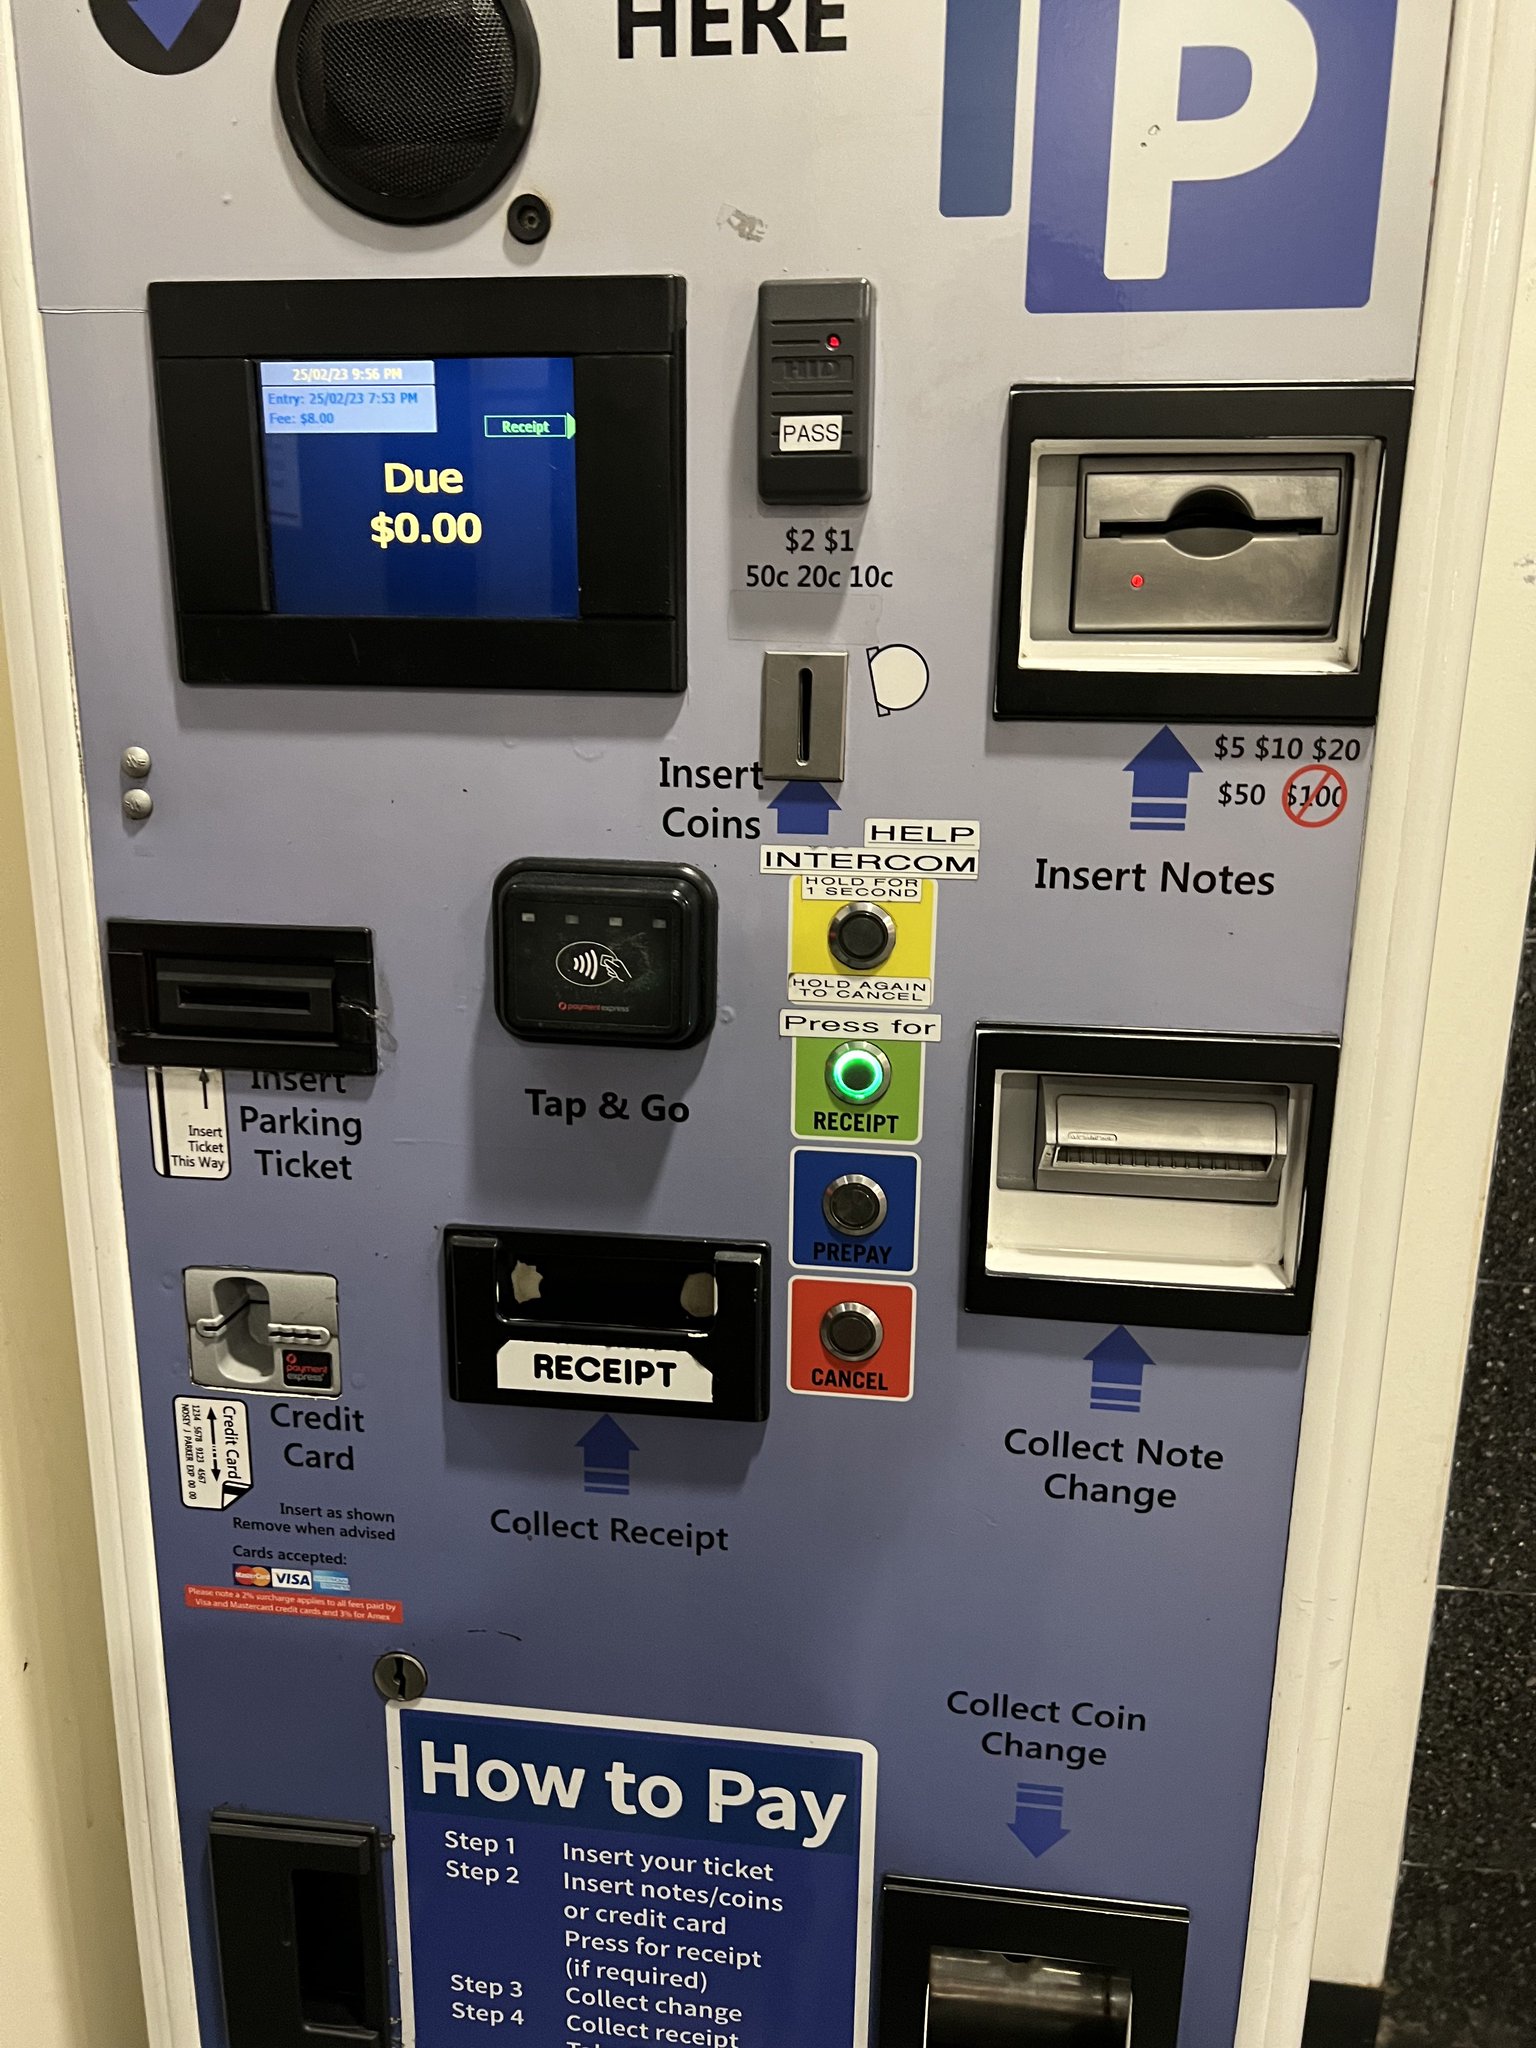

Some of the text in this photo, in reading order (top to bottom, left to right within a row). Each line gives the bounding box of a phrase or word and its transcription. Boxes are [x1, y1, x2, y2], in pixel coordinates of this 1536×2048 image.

[618, 0, 847, 59] HERE
[1103, 0, 1318, 280] P
[292, 368, 403, 382] 25/02/23 9:56 PM
[783, 360, 841, 380] HID
[268, 392, 418, 407] Entry: 25/02/23 7:53 PM
[269, 412, 335, 425] Fee: $8.00
[502, 420, 551, 436] Receipt
[783, 423, 839, 443] PASS
[384, 462, 464, 494] Due
[370, 511, 482, 549] $0.00
[785, 526, 854, 554] $2 $1
[746, 565, 894, 588] 50c 20c 10c
[1214, 733, 1361, 763] $5 $10 $20
[659, 757, 764, 790] Insert
[1218, 781, 1266, 807] $50
[662, 806, 761, 840] Coins
[871, 825, 975, 843] HELP
[765, 851, 976, 873] INTERCOM
[805, 876, 918, 888] HOLD FOR
[1034, 858, 1275, 896] Insert Notes
[807, 887, 918, 898] 1 SECOND
[792, 978, 926, 992] HOLD AGAIN
[798, 988, 923, 1002] TO CANCEL
[785, 1015, 936, 1035] Press for
[251, 1070, 347, 1094] Insert
[525, 1088, 690, 1126] Tap & Go
[188, 1125, 223, 1138] Insert
[239, 1105, 363, 1146] Parking
[813, 1111, 899, 1134] RECEIPT
[188, 1140, 224, 1154] Ticket
[170, 1155, 226, 1172] This Way
[254, 1149, 353, 1180] Ticket
[813, 1242, 892, 1264] PREPAY
[534, 1353, 677, 1388] RECEIPT
[811, 1368, 888, 1391] CANCEL
[182, 1403, 191, 1427] NOSEY
[270, 1402, 366, 1433] Credit
[184, 1436, 193, 1461] PARKER
[192, 1405, 206, 1484] 1234 5678 9123 4567
[223, 1405, 241, 1480] Credit Card
[1004, 1428, 1224, 1470] Collect Note
[283, 1442, 355, 1471] Card
[186, 1465, 195, 1477] EXP
[1044, 1473, 1177, 1514] Change
[280, 1503, 395, 1523] Insert as shown
[233, 1517, 395, 1541] Remove when advised
[490, 1509, 729, 1556] Collect Receipt
[233, 1545, 347, 1566] Cards accepted:
[276, 1573, 310, 1586] VISA
[188, 1587, 214, 1596] Please
[242, 1591, 255, 1599] 2%
[256, 1593, 295, 1603] surcharge
[347, 1600, 364, 1608] fees
[366, 1602, 384, 1611] paid
[386, 1603, 396, 1612] by
[275, 1604, 298, 1613] credit
[300, 1607, 321, 1615] cards
[322, 1609, 338, 1617] and
[367, 1612, 390, 1620] Amex
[947, 1690, 1146, 1732] Collect Coin
[981, 1731, 1107, 1770] Change
[420, 1740, 847, 1849] How to Pay
[444, 1830, 515, 1857] Step 1
[445, 1860, 520, 1886] Step 2
[562, 1842, 774, 1882] Insert your ticket
[563, 1872, 784, 1913] Insert notes/coins
[563, 1904, 728, 1935] or credit card
[565, 1930, 762, 1970] Press for receipt
[450, 1974, 523, 1999] Step 3
[565, 1957, 708, 1994] (if required)
[452, 2002, 524, 2027] Step 4
[565, 1987, 742, 2025] Collect change
[566, 2014, 739, 2048] Collect receipt
